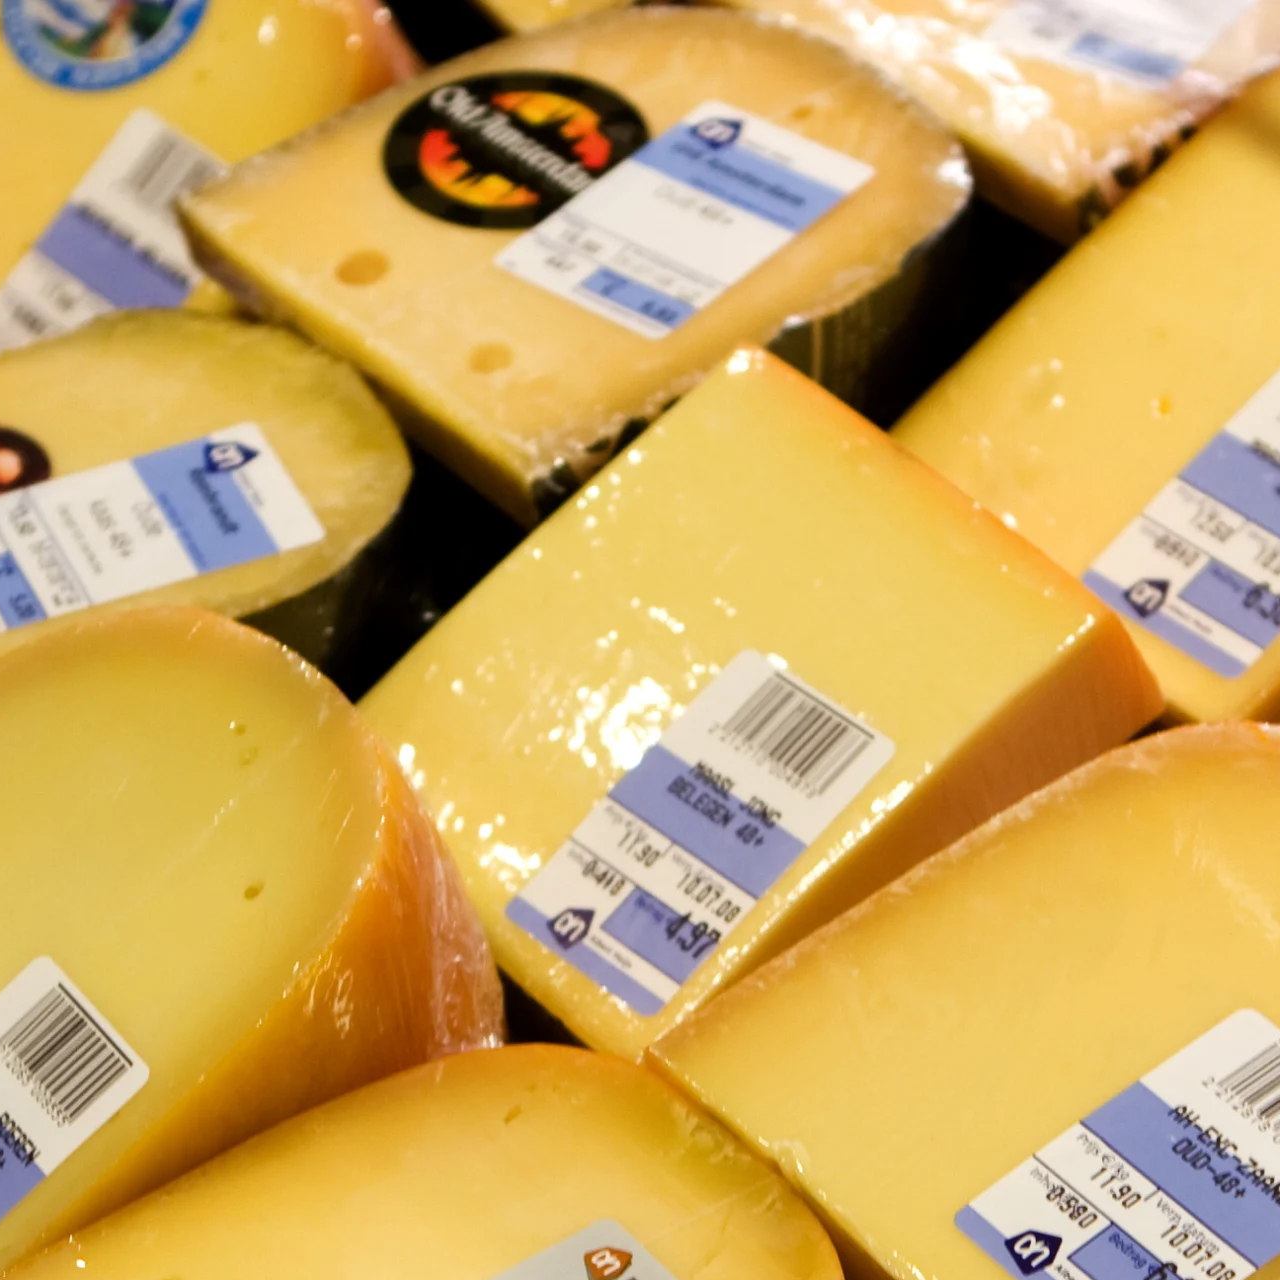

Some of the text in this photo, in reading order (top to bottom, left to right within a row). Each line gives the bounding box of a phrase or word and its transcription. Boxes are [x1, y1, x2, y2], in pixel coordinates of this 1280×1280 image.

[468, 104, 594, 194] Amsterda
[670, 777, 767, 849] BELEGEN 48+
[675, 871, 741, 925] 10.07.08
[663, 909, 722, 961] 4.97
[1087, 1166, 1143, 1209] 11.90
[1168, 1136, 1251, 1200] OUD-48+
